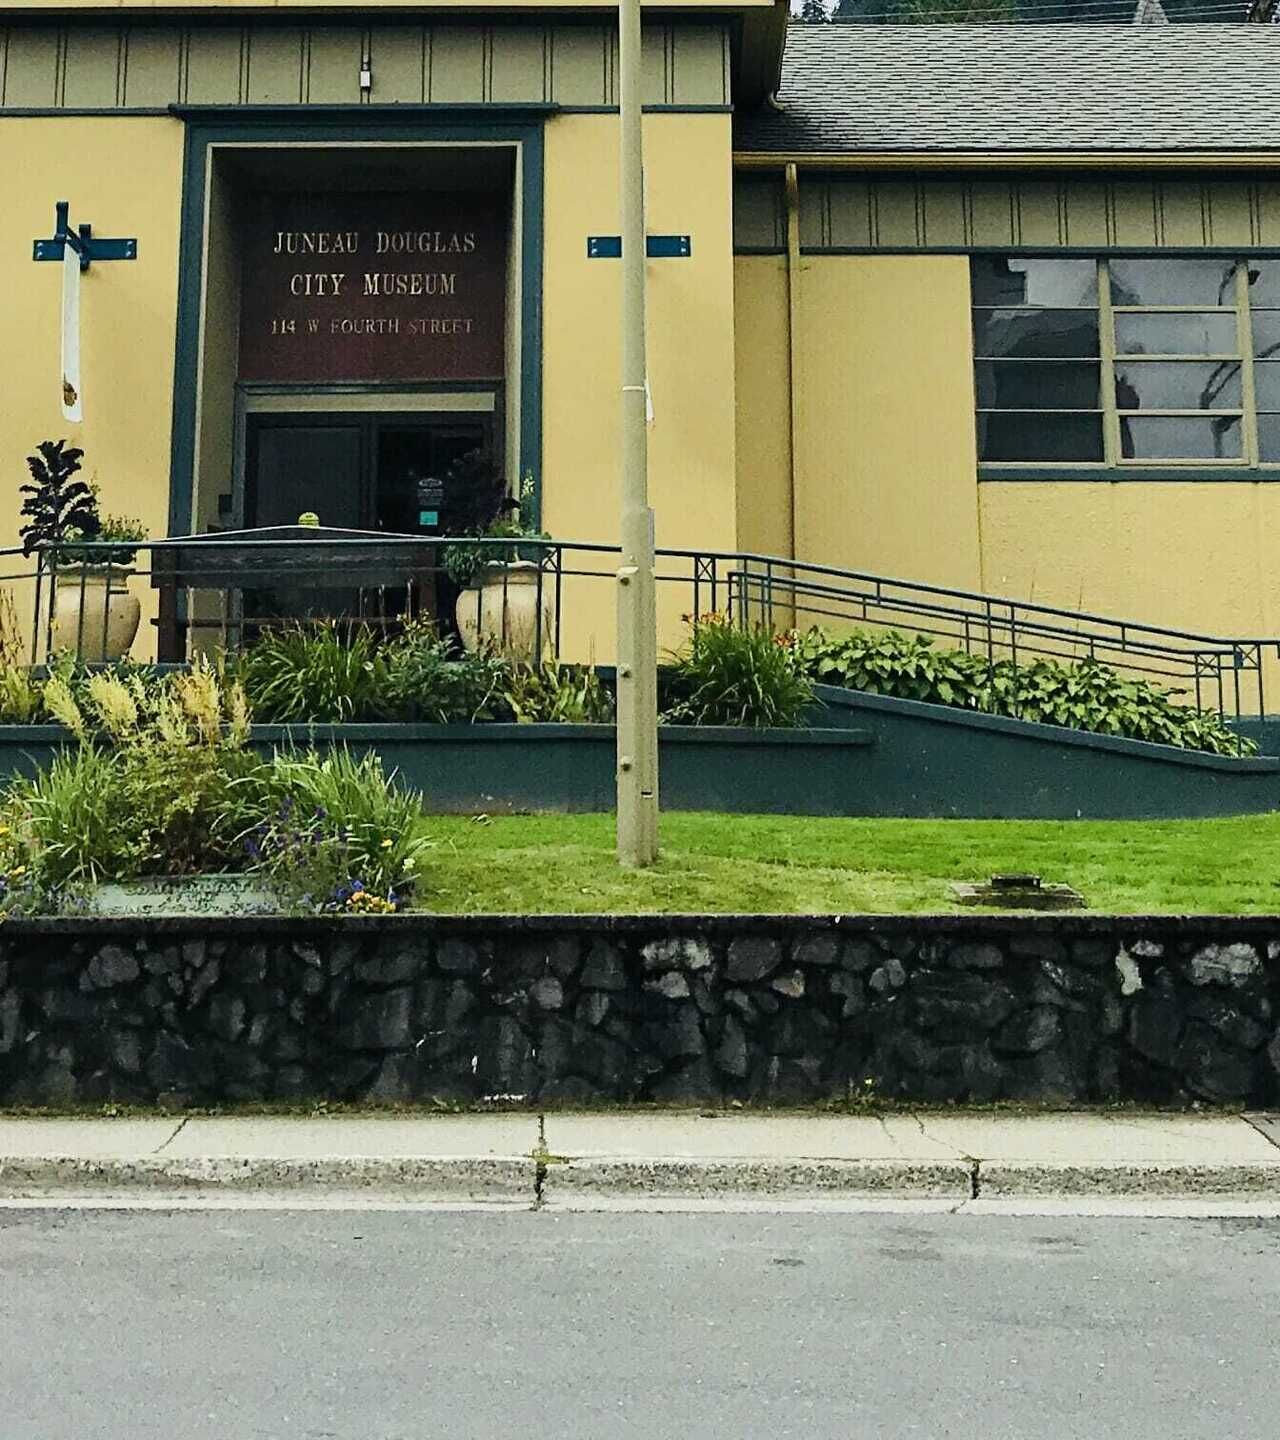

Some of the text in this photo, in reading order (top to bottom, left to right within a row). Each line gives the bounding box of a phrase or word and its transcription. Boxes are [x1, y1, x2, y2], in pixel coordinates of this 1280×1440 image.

[273, 231, 476, 254] JUNEAU DOUGLAS
[290, 273, 457, 296] CITY MUSEUM
[271, 319, 473, 335] 114 W FOURTH STREET
